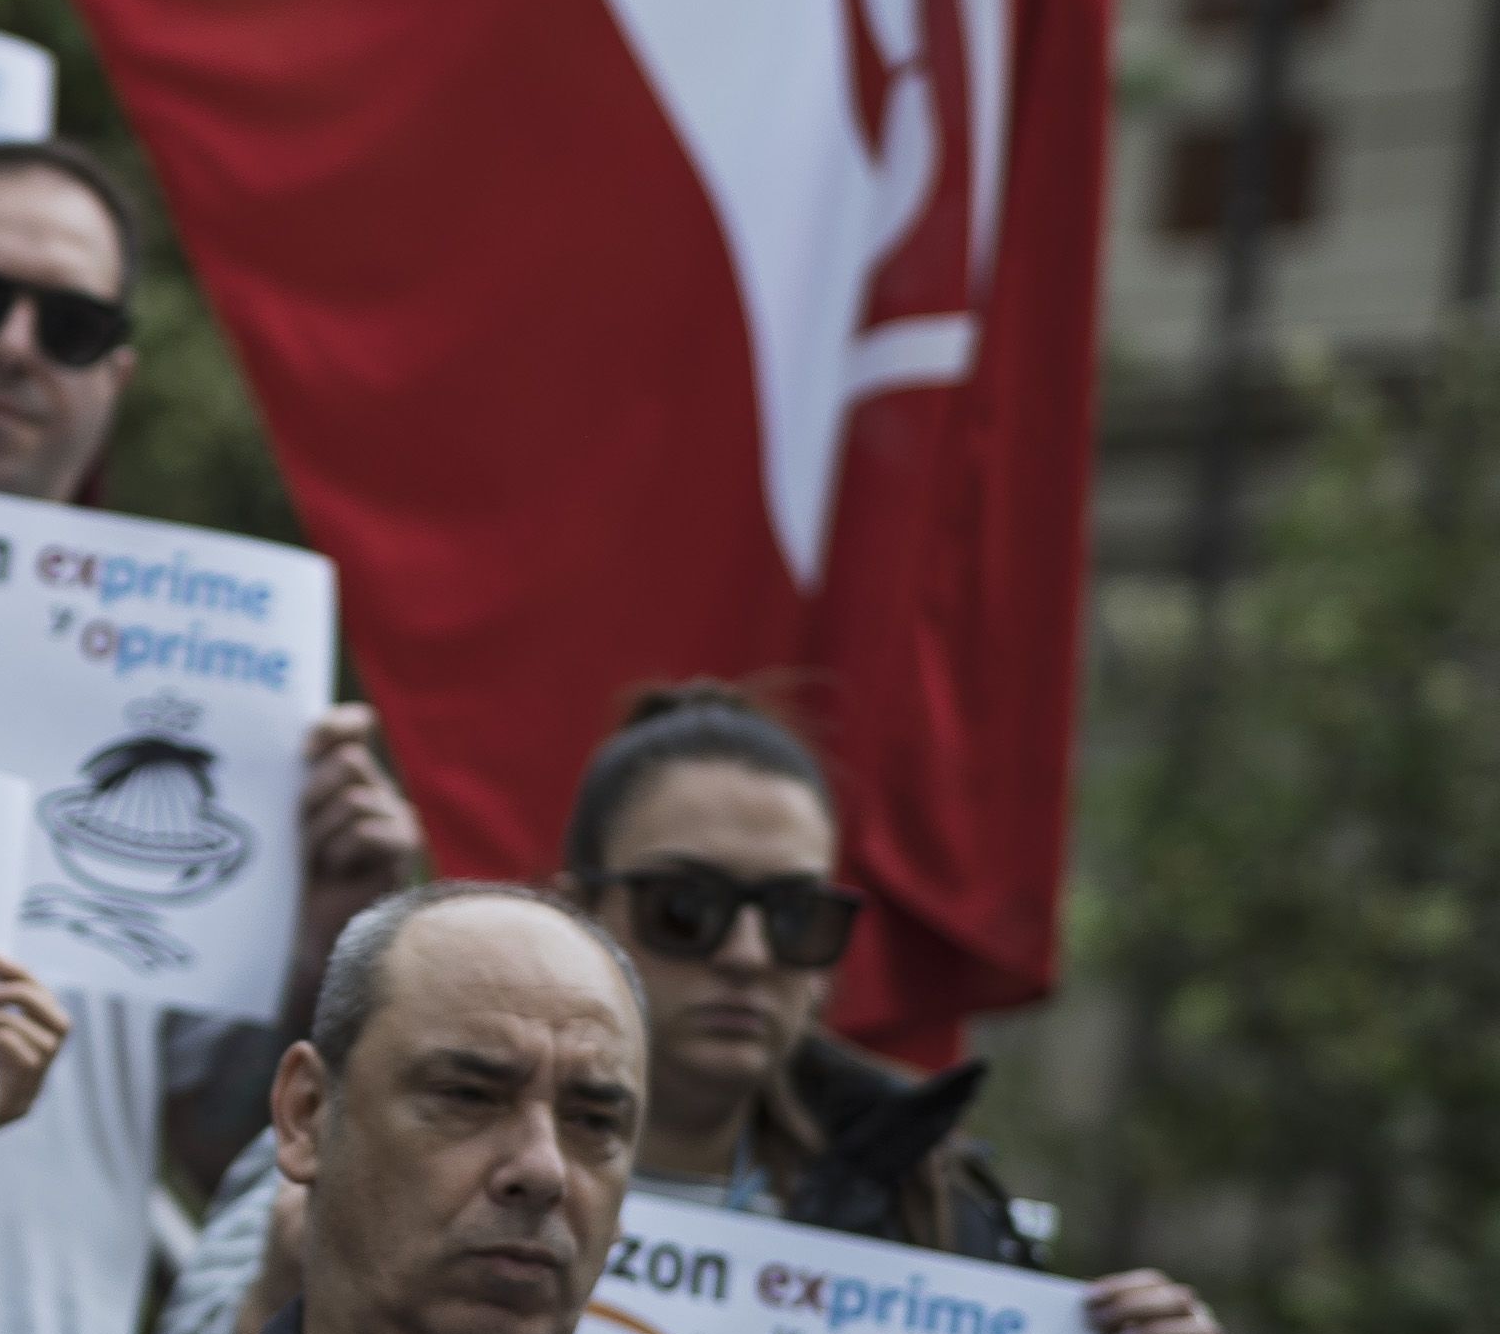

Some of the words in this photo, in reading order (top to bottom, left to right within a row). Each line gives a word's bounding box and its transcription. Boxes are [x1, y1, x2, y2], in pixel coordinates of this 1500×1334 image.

[34, 543, 273, 625] exprime
[78, 613, 291, 693] oprime
[606, 1233, 728, 1302] zon
